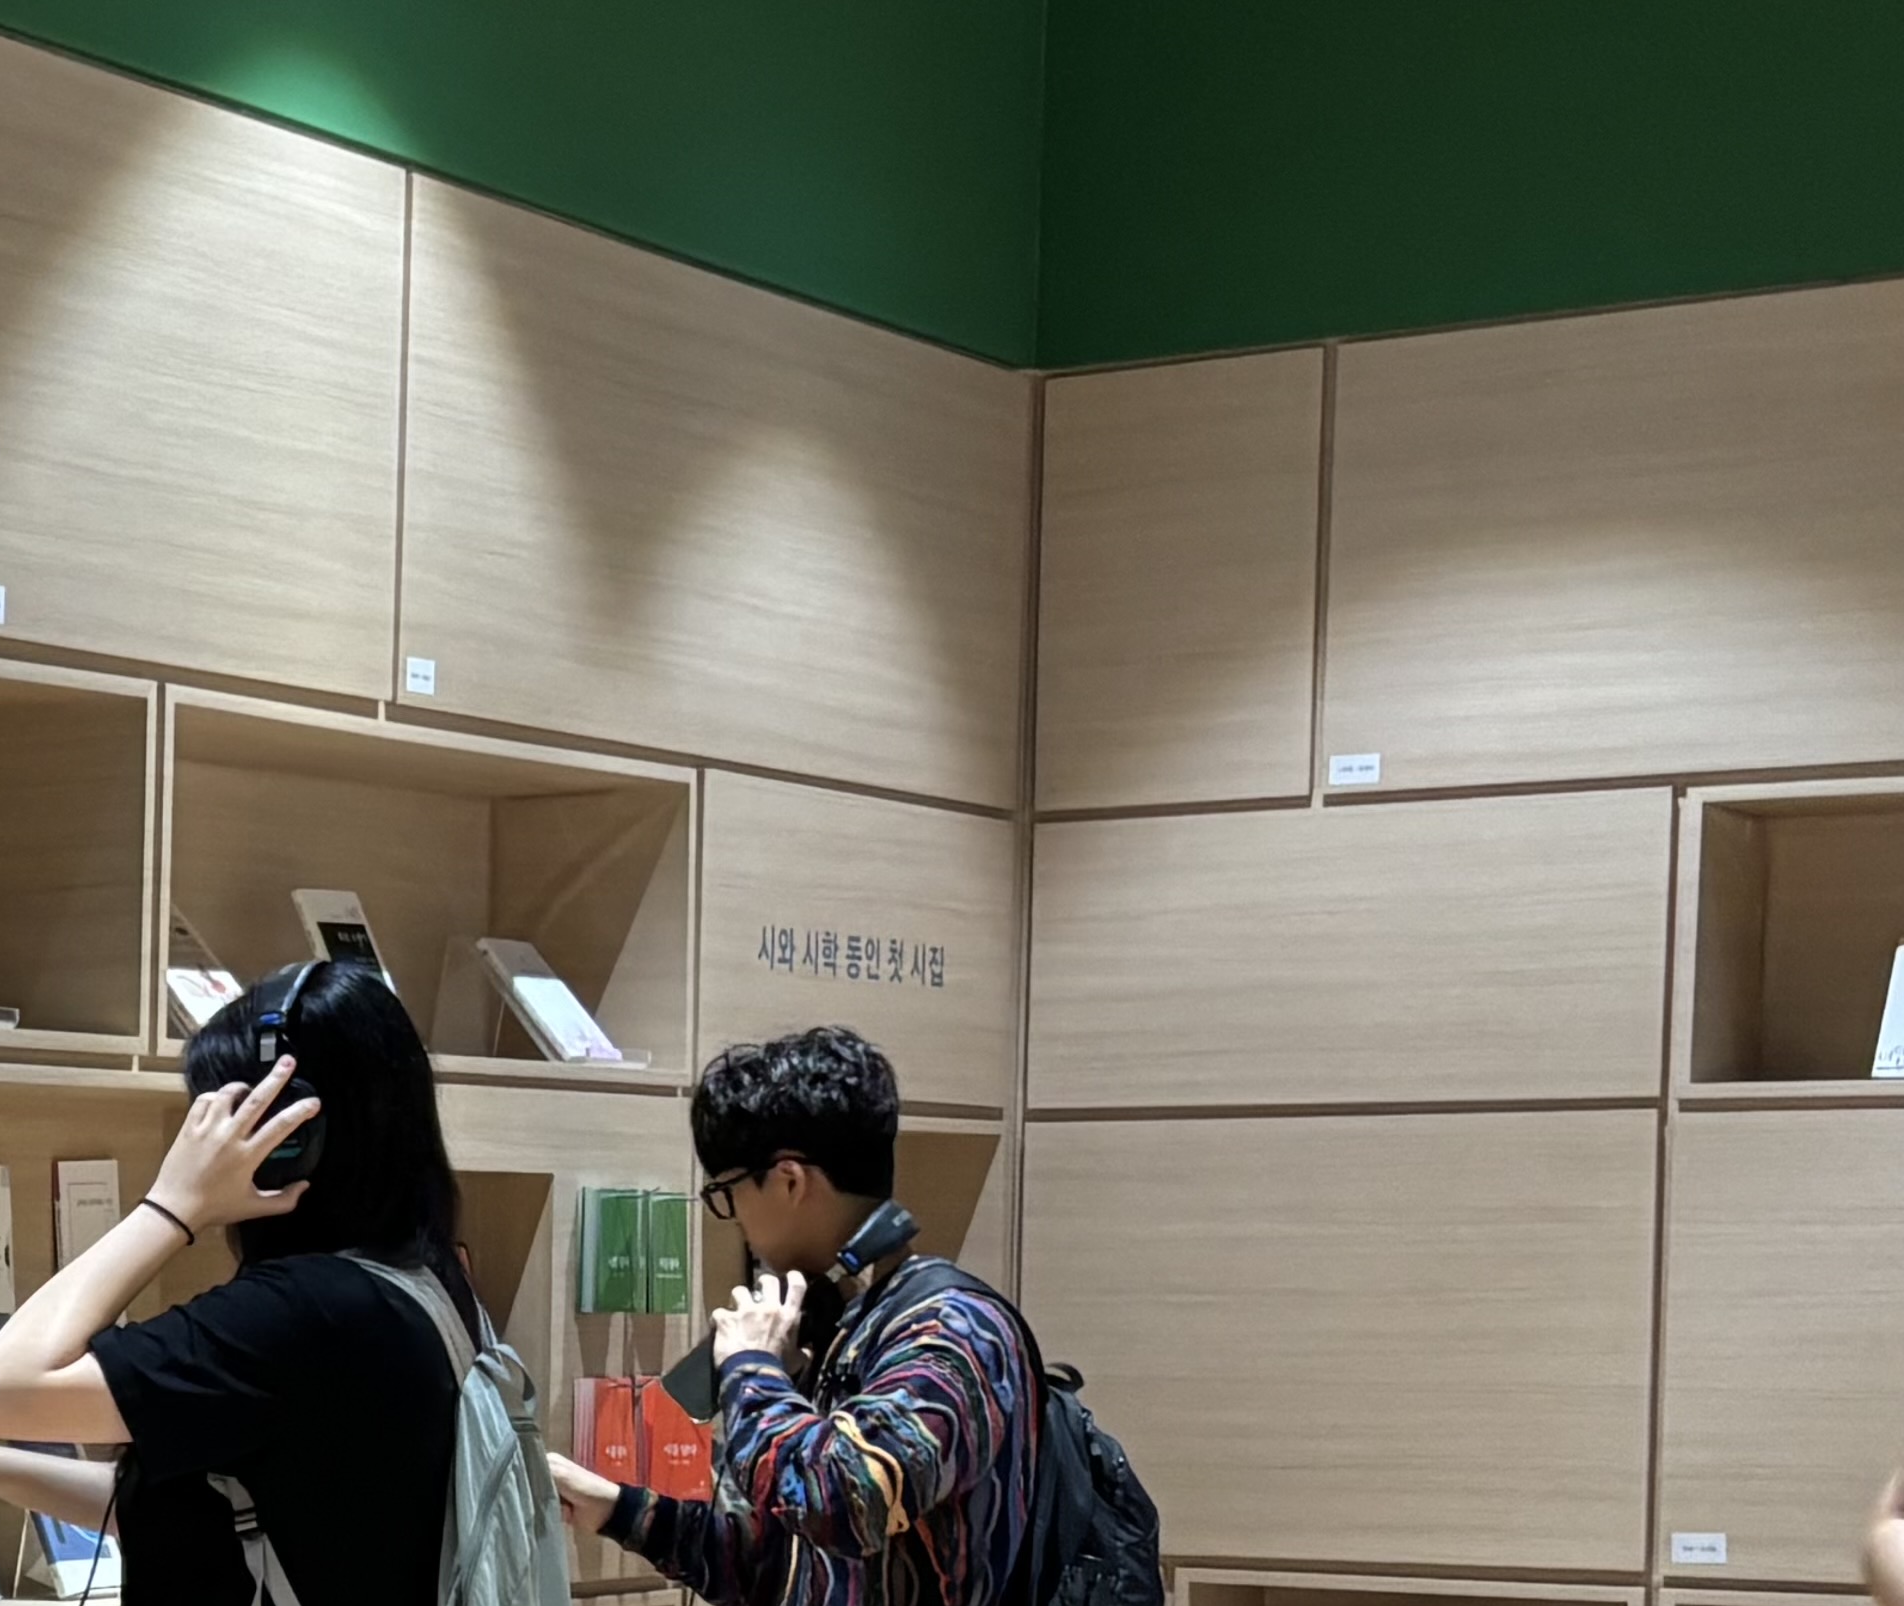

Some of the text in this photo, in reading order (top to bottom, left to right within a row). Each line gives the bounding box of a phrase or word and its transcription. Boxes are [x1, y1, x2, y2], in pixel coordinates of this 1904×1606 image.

[758, 924, 945, 988] 시와 시학 동인 첫 시집
